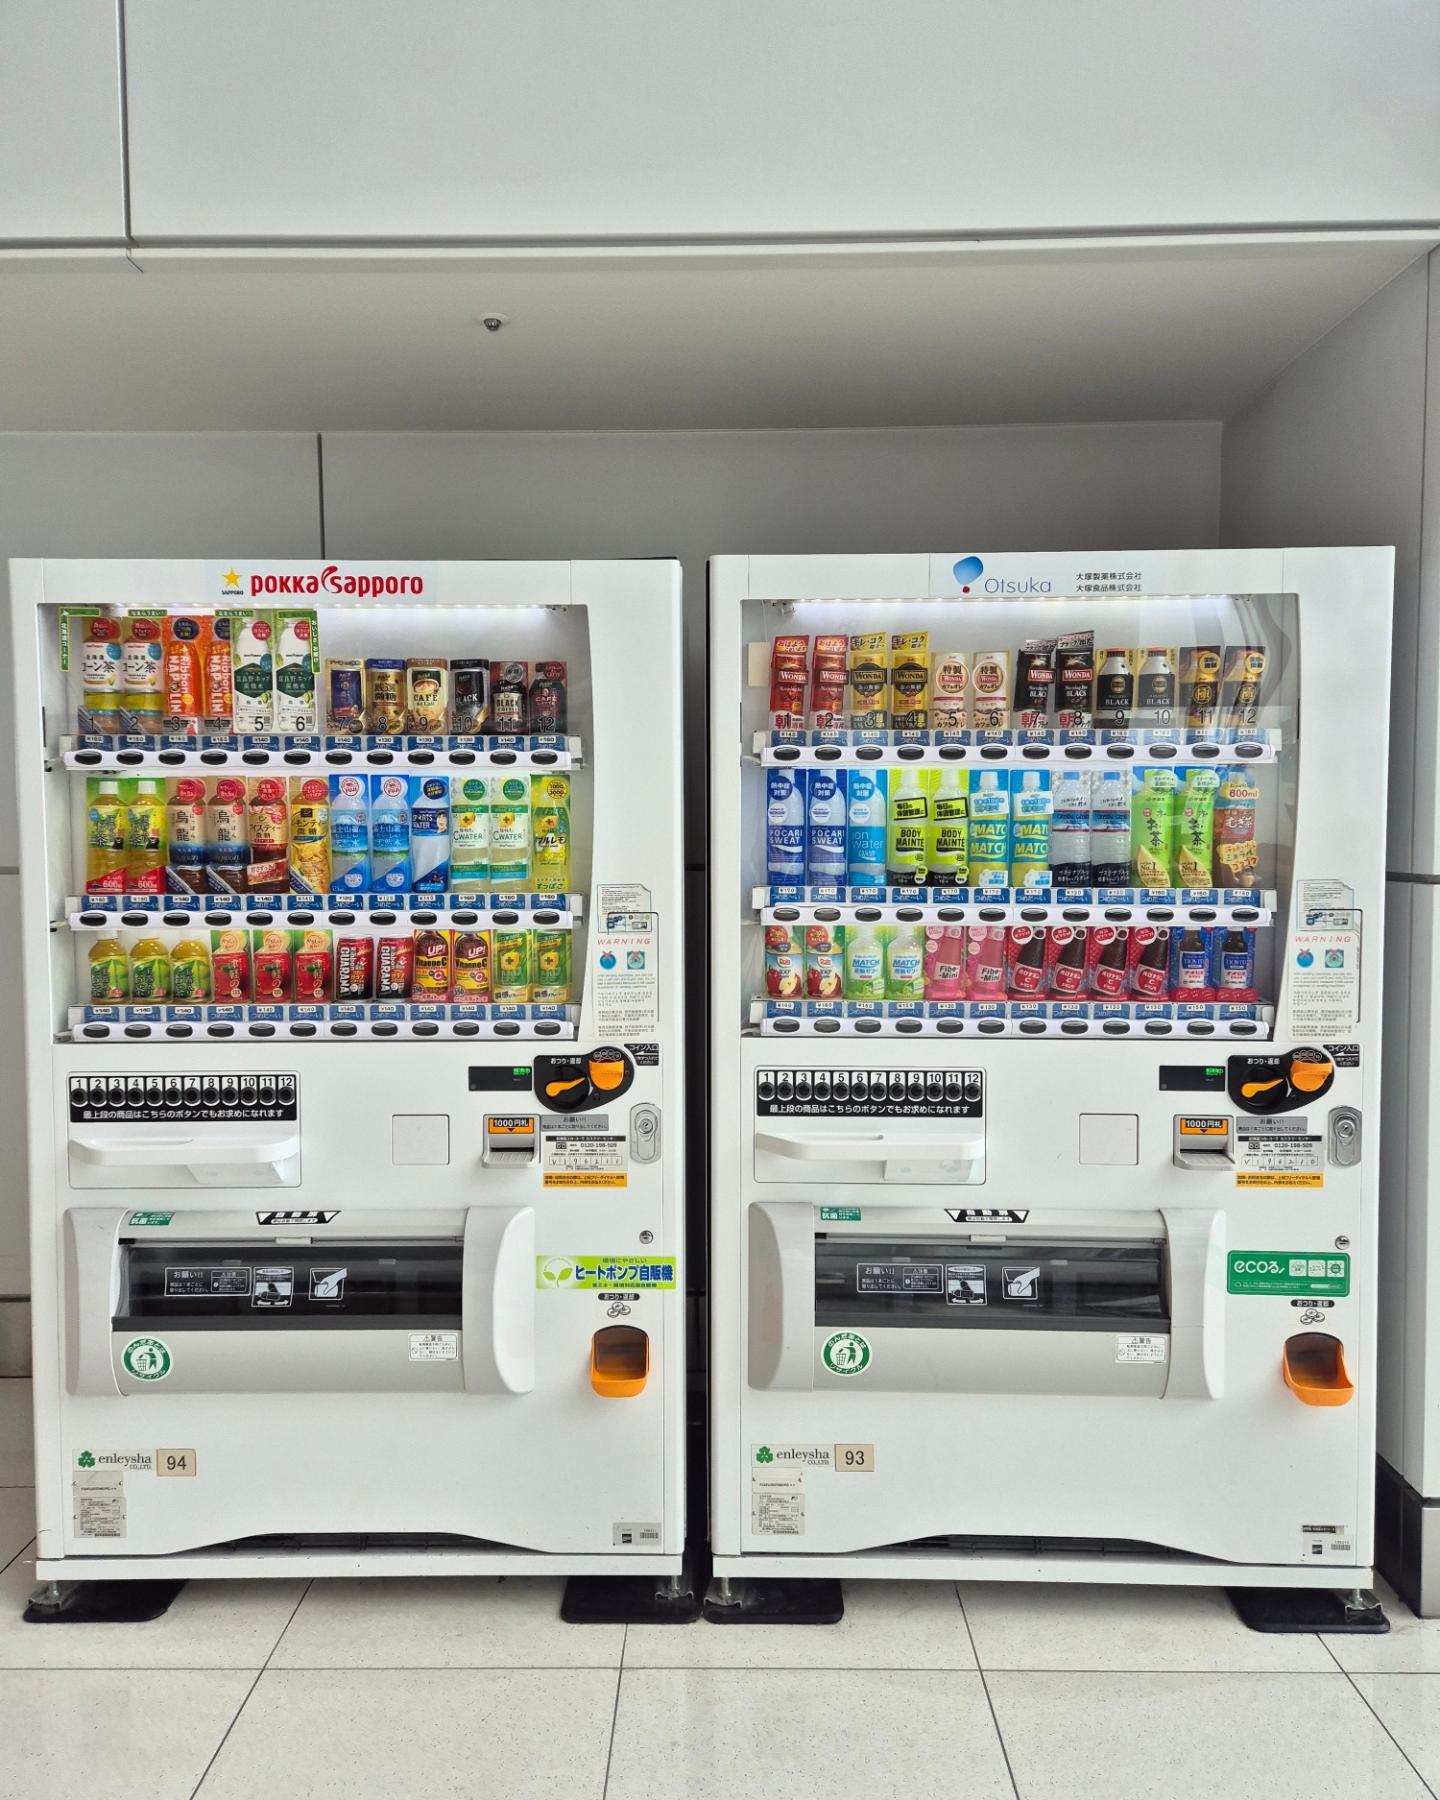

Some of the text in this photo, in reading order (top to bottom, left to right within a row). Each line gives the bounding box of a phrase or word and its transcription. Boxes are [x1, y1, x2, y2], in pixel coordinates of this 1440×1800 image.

[1076, 572, 1142, 581] 大塚製薬株式会社
[984, 577, 1051, 594] Otsuka
[1076, 584, 1141, 592] 大塚食品株式会社
[781, 671, 806, 681] WONDA
[822, 671, 848, 681] WONDA
[856, 672, 882, 680] WONDA
[897, 672, 924, 680] WONDA
[1030, 671, 1053, 681] WONDA
[1064, 671, 1091, 680] WONDA
[88, 717, 95, 730] 1
[129, 717, 139, 730] 2
[171, 717, 180, 730] 3
[212, 717, 222, 730] 4
[254, 717, 264, 731] 5
[296, 717, 305, 731] 6
[378, 717, 387, 731] 8
[419, 717, 428, 730] 9
[458, 717, 473, 731] 10
[499, 717, 514, 730] 11
[538, 717, 554, 730] 12
[769, 829, 803, 837] POCARI
[811, 829, 844, 837] POCARI
[900, 829, 922, 838] BODY
[941, 829, 962, 838] BODY
[770, 837, 800, 845] SWEAT
[811, 837, 842, 845] SWEAT
[851, 840, 883, 849] water
[896, 838, 924, 848] MAINTE
[936, 838, 965, 848] MAINTE
[1295, 935, 1351, 943] WARNING
[427, 945, 446, 955] UP!
[468, 946, 486, 958] UP!
[852, 958, 880, 967] MATCH
[892, 958, 920, 967] MATCH
[340, 946, 350, 994] GUARANA
[380, 946, 390, 994] GUARANA
[764, 1073, 979, 1082] 1 2 3 4 5 6 7 8 9 10 11 12
[76, 1078, 292, 1088] 1 2 3 4 5 6 7 8 9 10 11 12
[770, 1104, 970, 1114] 最上段の商品はこちらのボタンでもお求めになれます
[83, 1110, 284, 1119] 最上段の商品はこちらのボタンでもお求めになれます
[494, 1119, 529, 1127] 1000円札
[1186, 1120, 1222, 1128] 1000円札
[575, 1264, 674, 1282] ヒートポンプ自販機
[98, 1453, 151, 1466] enleysha
[776, 1449, 830, 1462] enleysha
[845, 1451, 865, 1465] 93
[167, 1456, 186, 1470] 94
